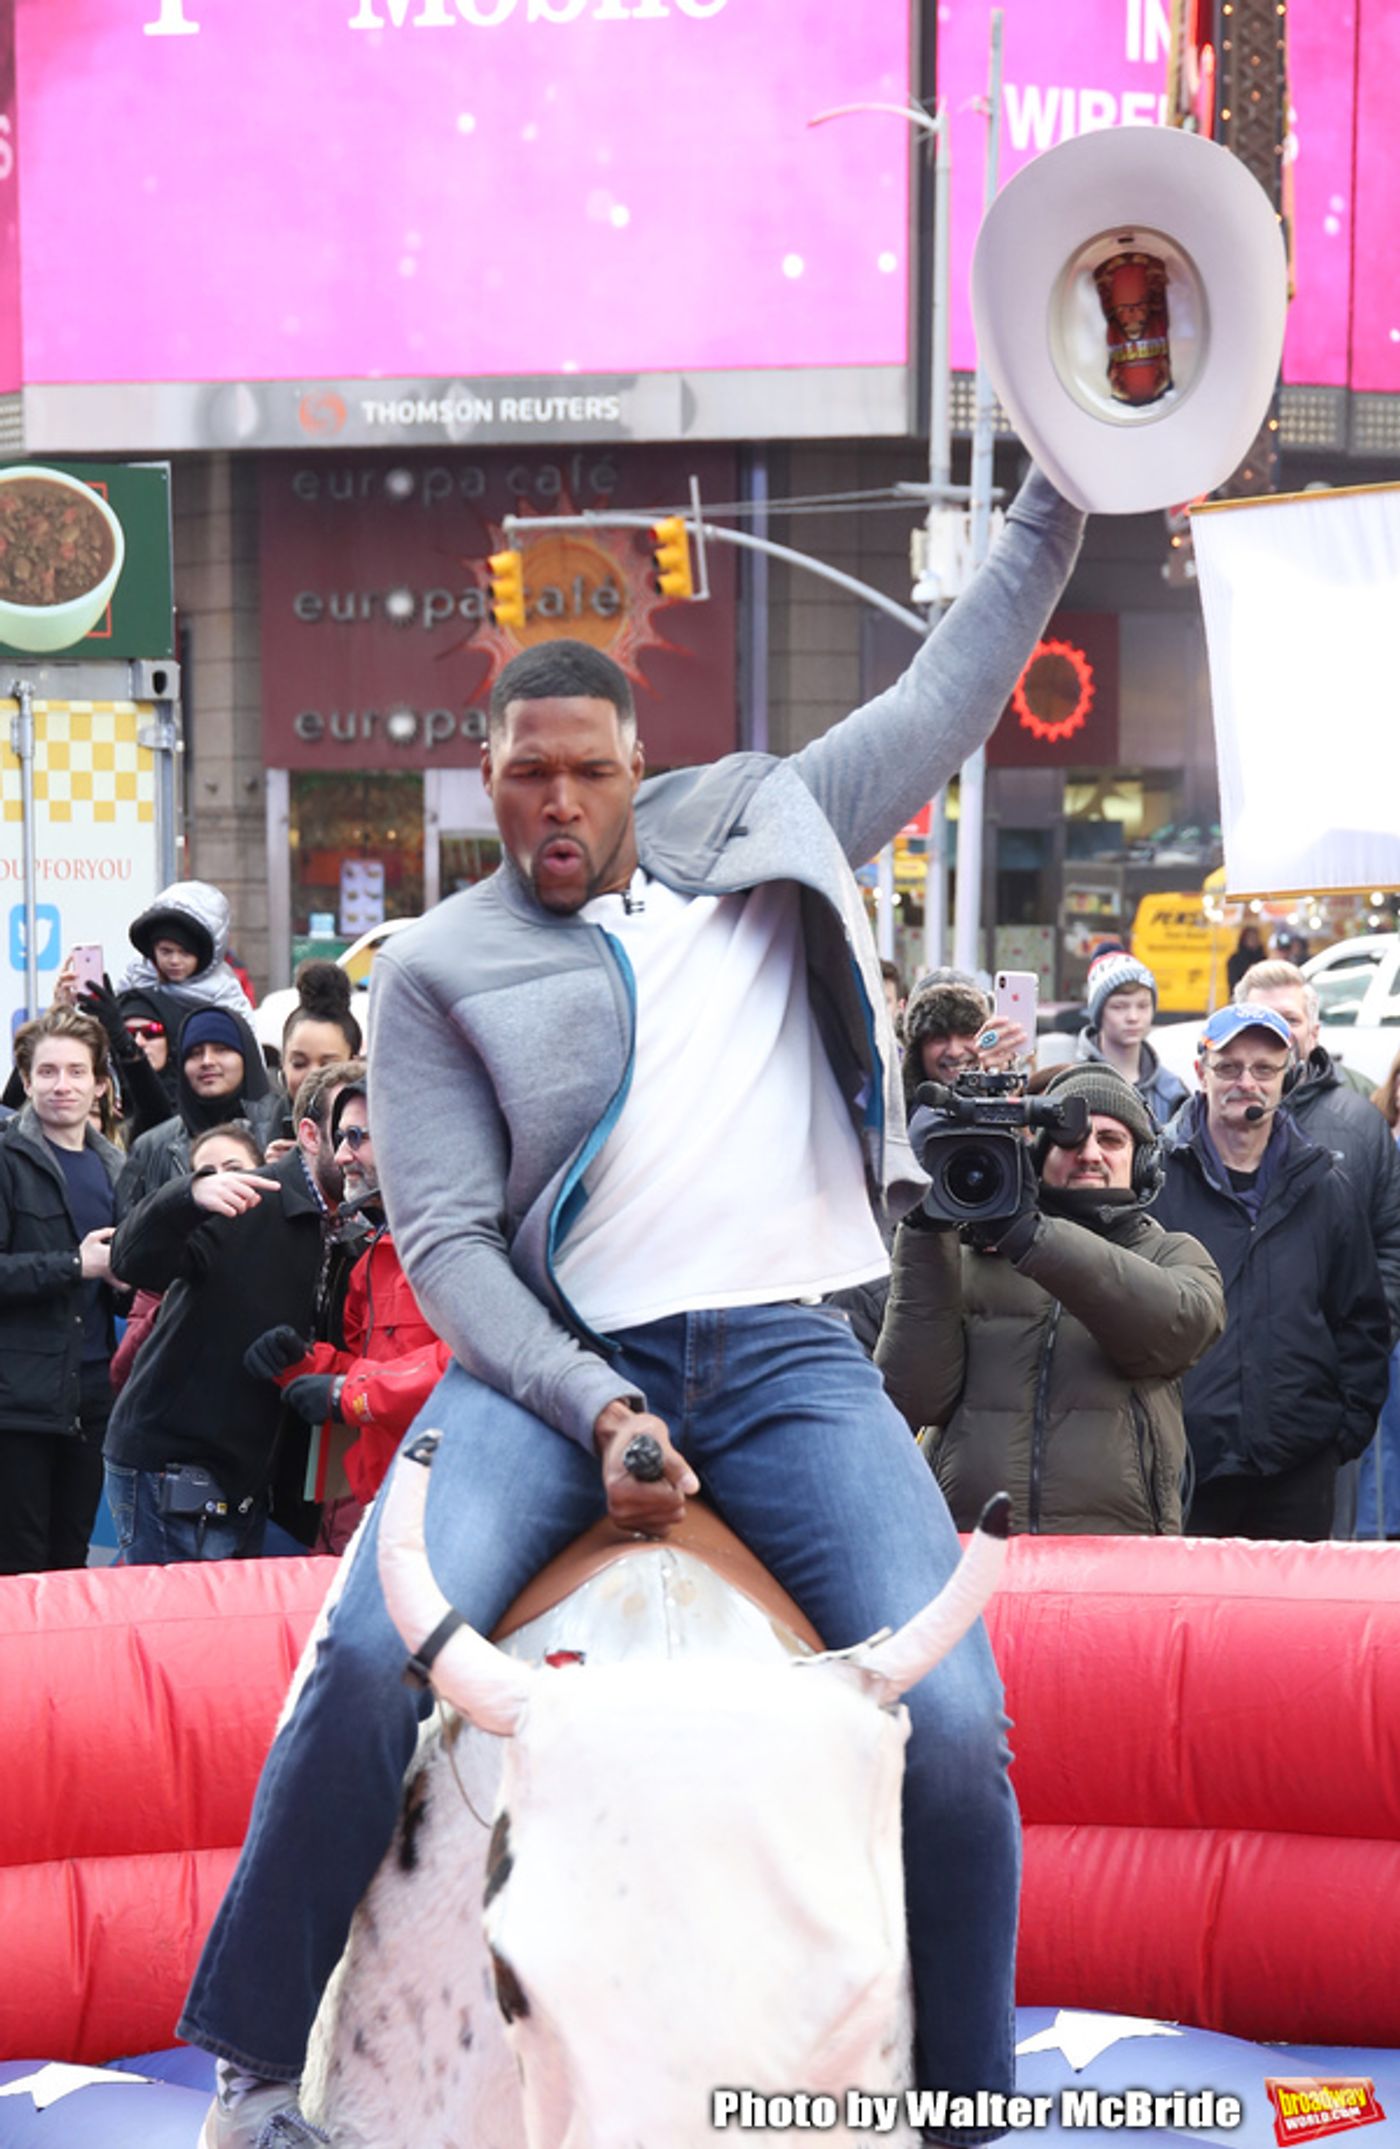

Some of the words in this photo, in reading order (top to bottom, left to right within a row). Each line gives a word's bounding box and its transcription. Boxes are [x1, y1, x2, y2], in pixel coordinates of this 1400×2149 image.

[1003, 84, 1170, 149] WIRE
[362, 399, 494, 424] THOMSON
[501, 396, 620, 421] REUTERS
[293, 464, 486, 507] europa
[506, 454, 617, 496] café
[294, 587, 487, 628] europa
[523, 576, 622, 617] afé
[294, 708, 487, 746] europa
